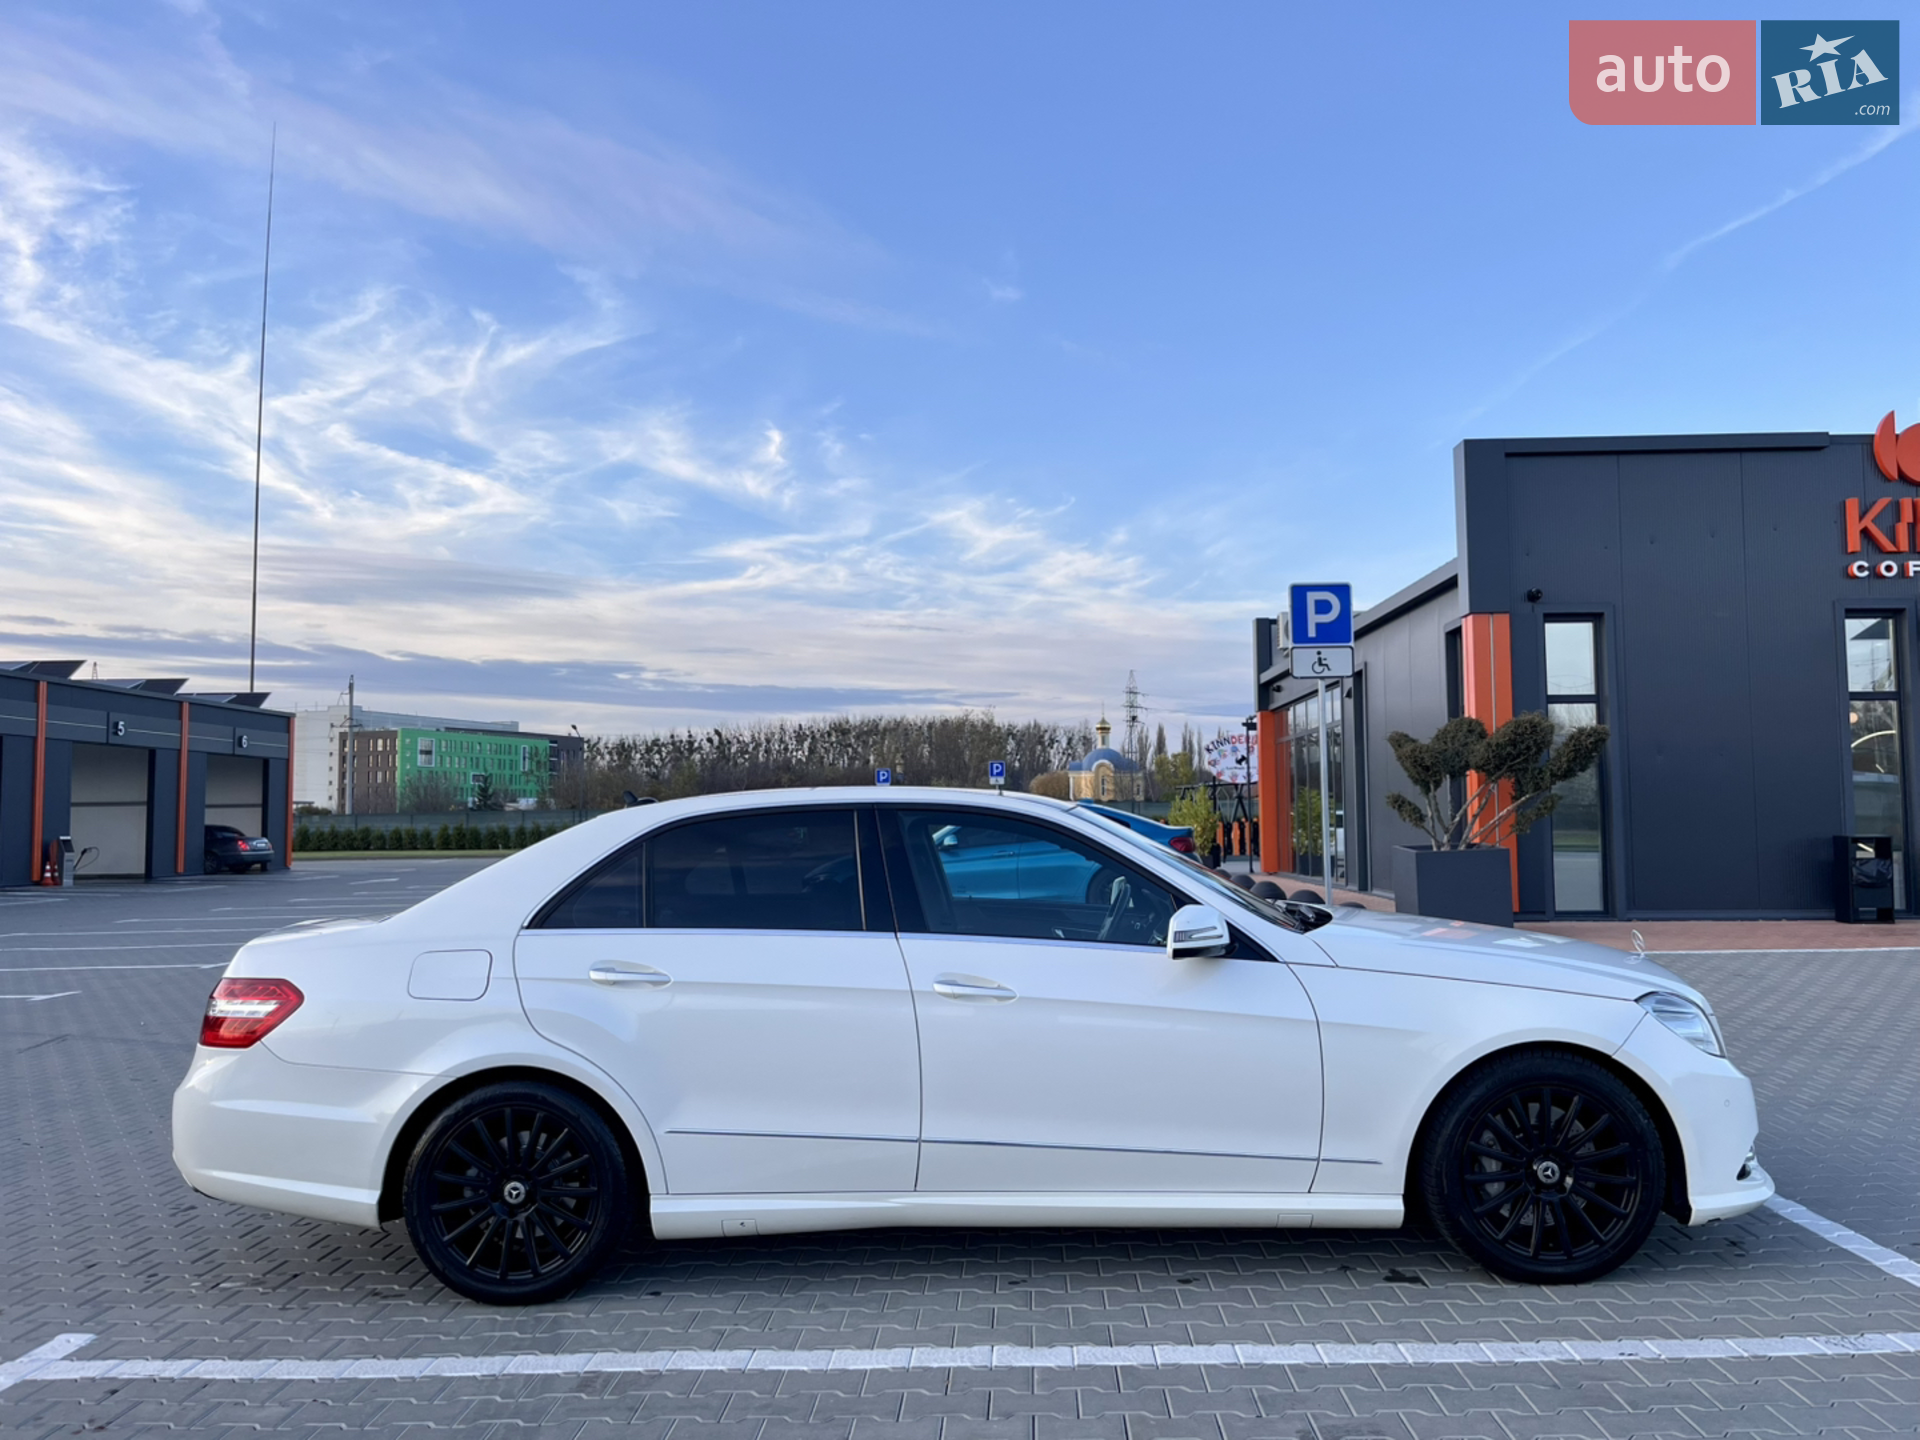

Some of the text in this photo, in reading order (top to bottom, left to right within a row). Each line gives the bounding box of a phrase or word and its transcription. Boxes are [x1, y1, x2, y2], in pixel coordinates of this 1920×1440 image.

[1306, 591, 1341, 638] P
[117, 720, 125, 736] 5
[241, 735, 249, 748] 6
[993, 763, 1002, 775] P
[879, 771, 888, 782] P
